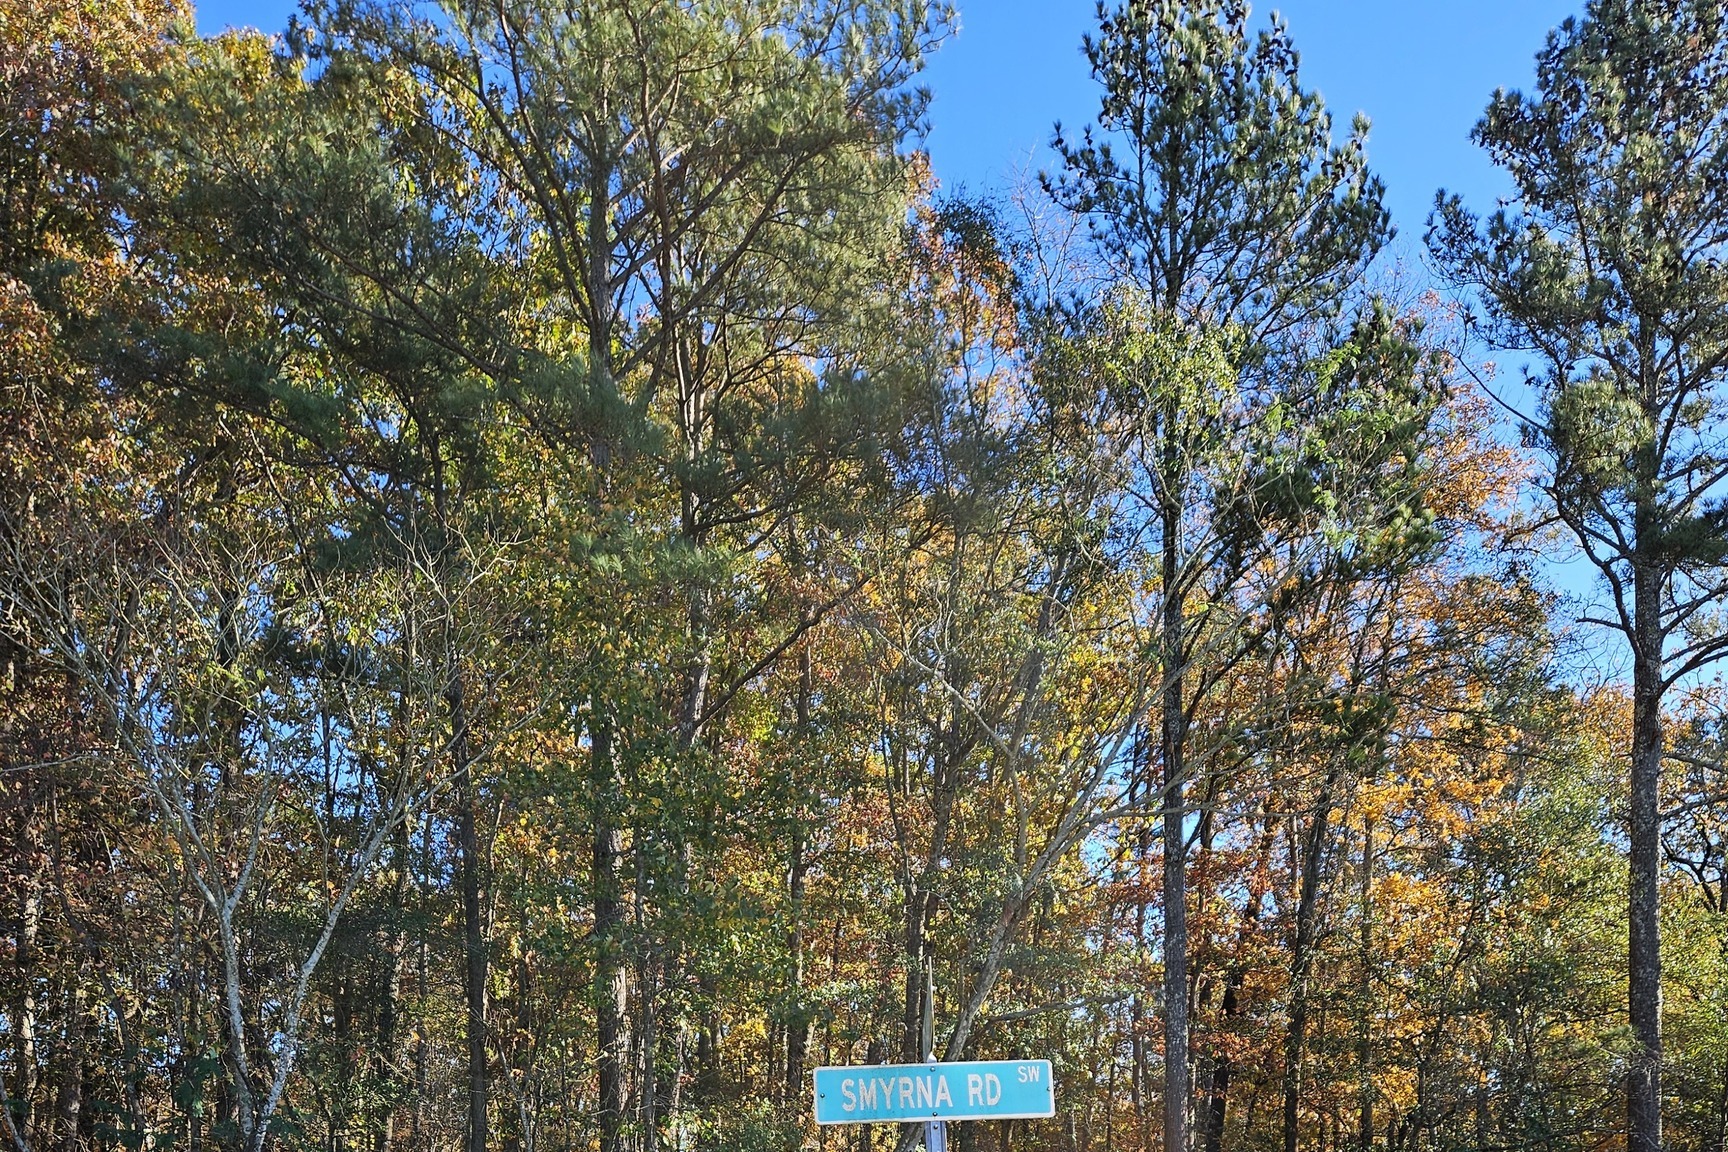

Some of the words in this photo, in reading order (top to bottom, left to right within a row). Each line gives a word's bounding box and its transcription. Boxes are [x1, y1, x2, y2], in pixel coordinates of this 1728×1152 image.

[841, 1074, 953, 1112] SMYRNA
[967, 1073, 1001, 1107] RD
[1017, 1065, 1040, 1083] SW
